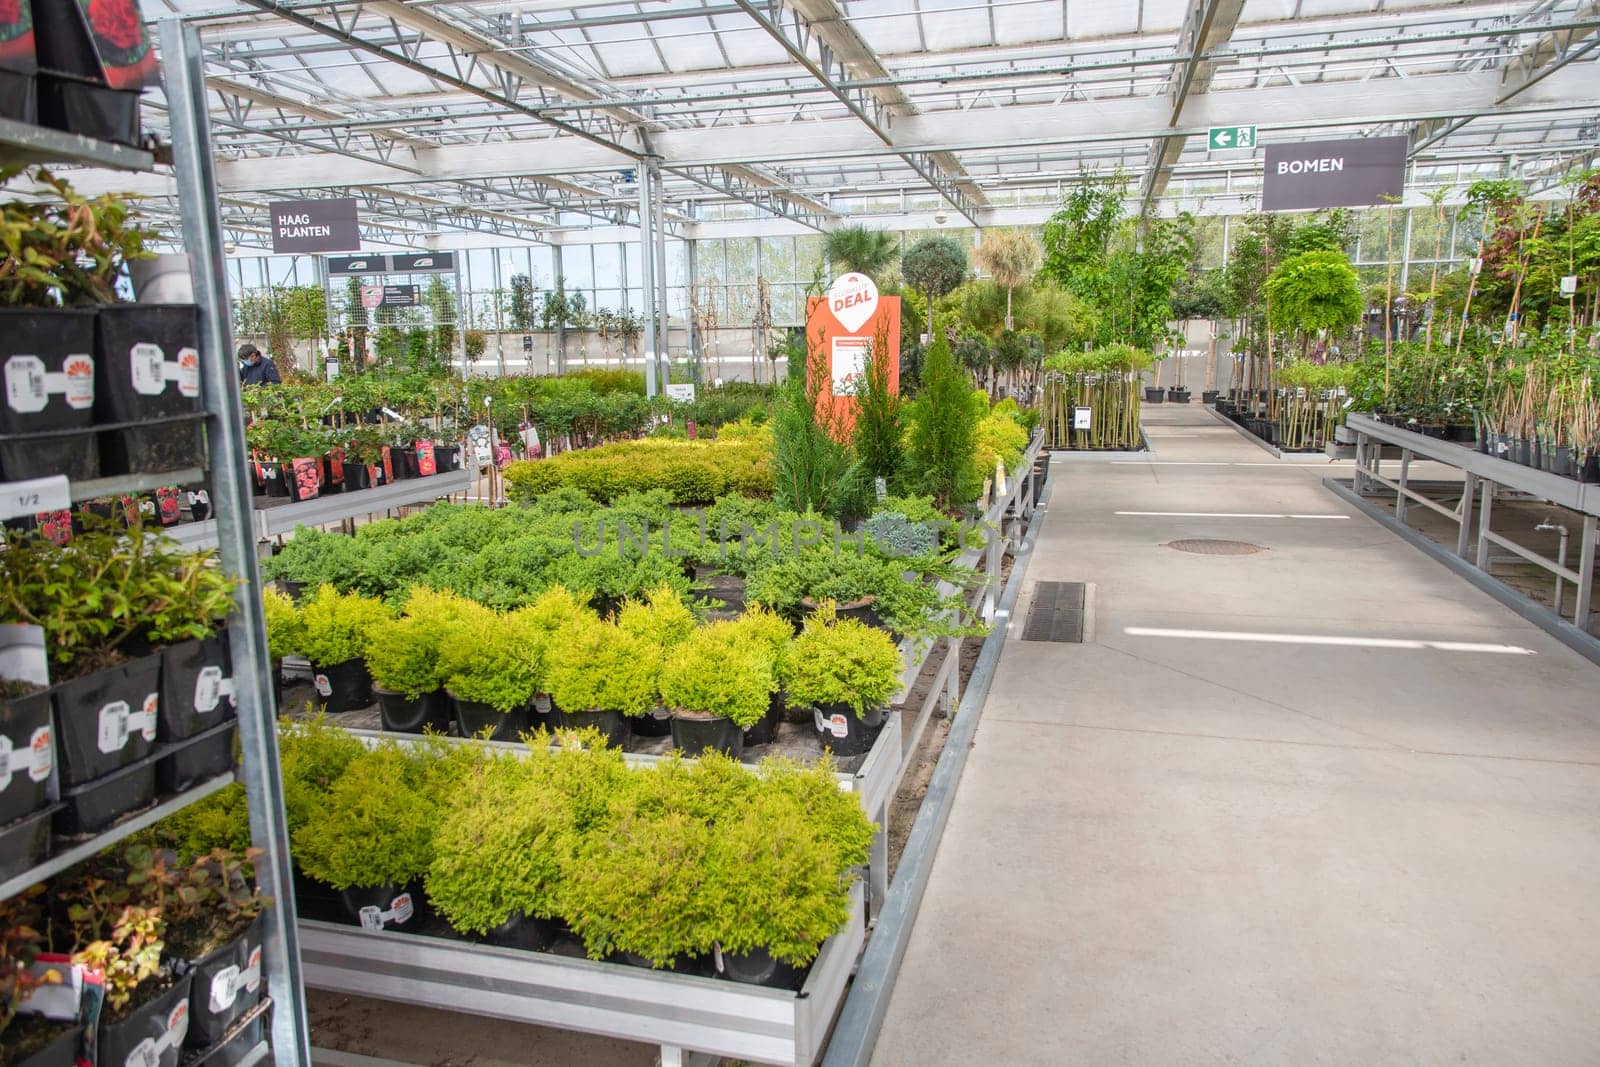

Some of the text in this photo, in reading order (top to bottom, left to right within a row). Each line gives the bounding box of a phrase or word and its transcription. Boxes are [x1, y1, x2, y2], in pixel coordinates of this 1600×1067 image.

[1278, 158, 1344, 175] BOMEN
[278, 214, 310, 225] HAAG
[279, 226, 330, 238] PLANTEN
[834, 290, 872, 312] DEAL
[19, 494, 39, 506] 1/2
